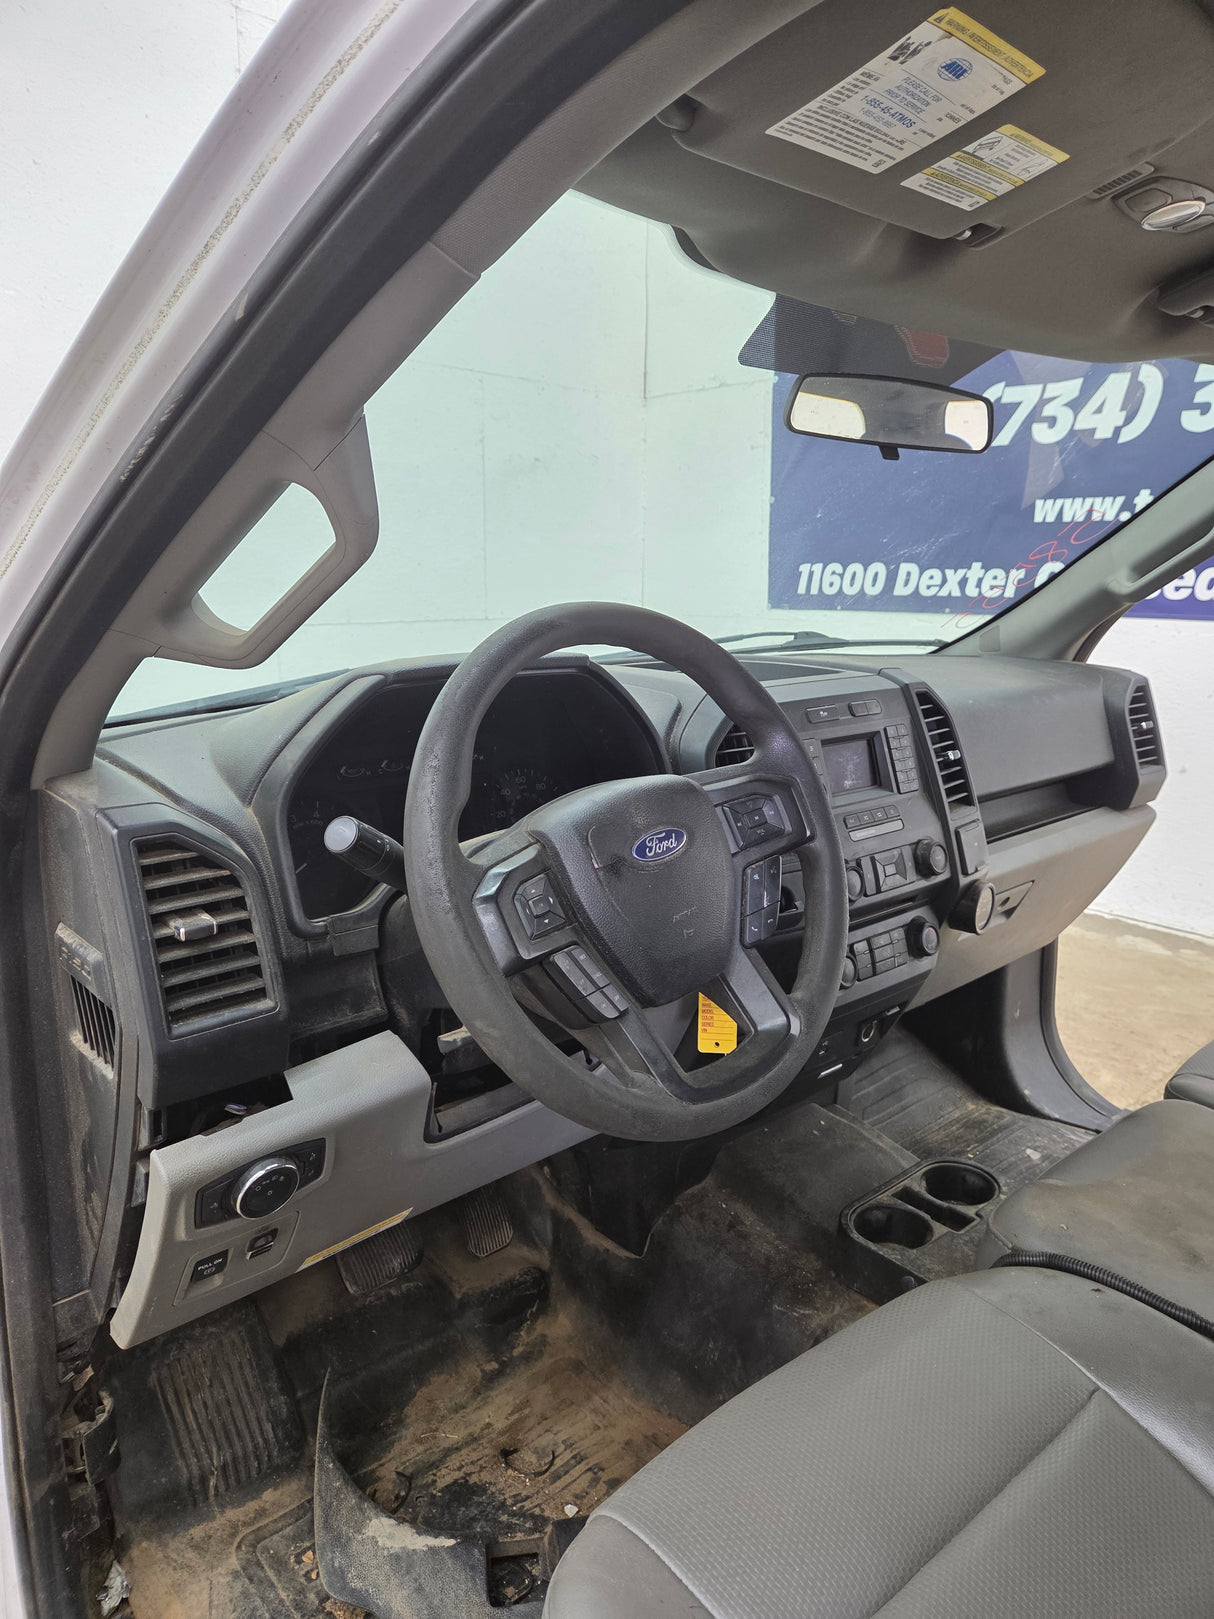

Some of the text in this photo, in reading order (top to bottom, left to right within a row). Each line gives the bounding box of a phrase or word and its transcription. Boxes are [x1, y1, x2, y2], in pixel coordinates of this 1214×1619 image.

[903, 77, 923, 90] PLEASE
[919, 87, 932, 97] CALL
[797, 562, 887, 596] 11600
[893, 562, 1026, 598] Dexter
[646, 832, 678, 857] Ford
